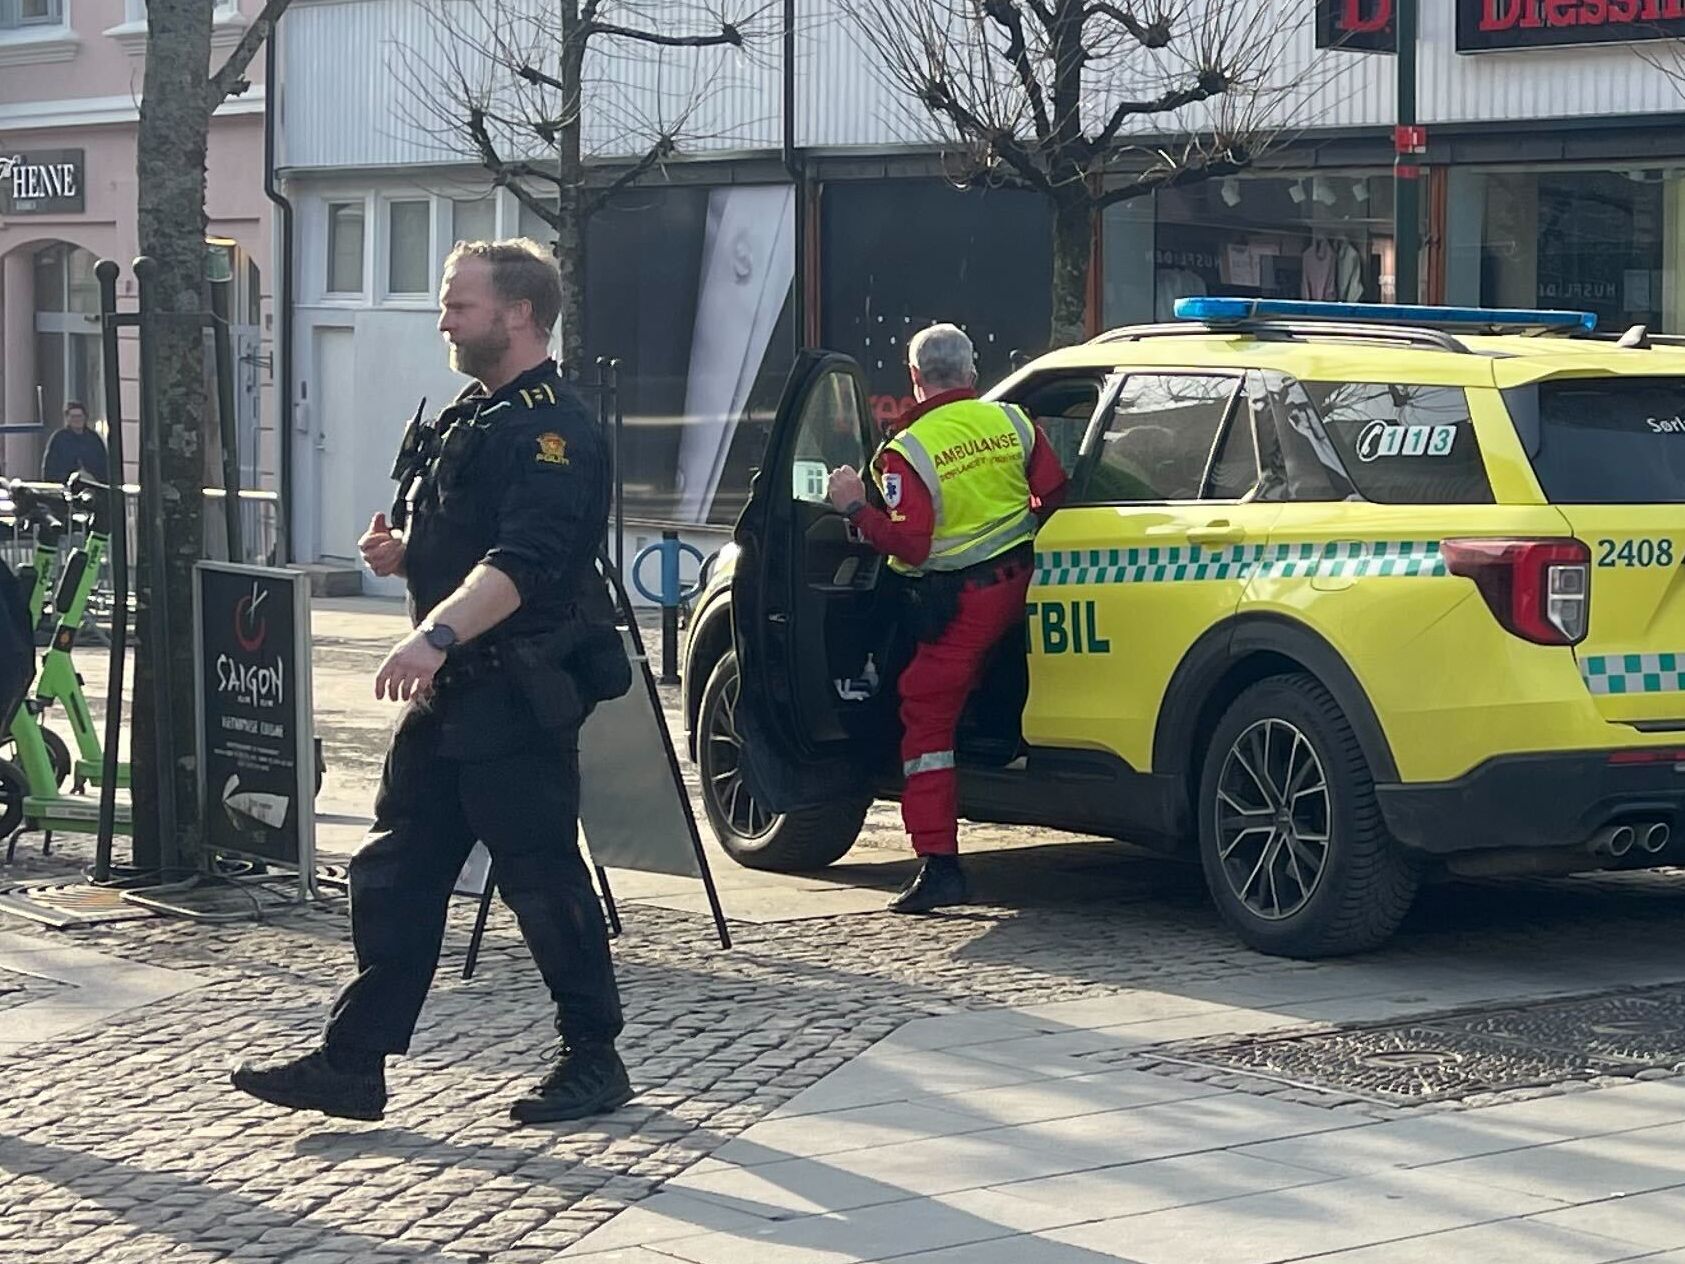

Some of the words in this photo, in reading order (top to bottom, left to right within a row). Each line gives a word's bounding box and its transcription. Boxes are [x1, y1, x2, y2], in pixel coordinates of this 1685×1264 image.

[12, 163, 76, 198] HENNE
[1384, 427, 1452, 453] 113
[1646, 416, 1685, 433] Sørl
[934, 432, 1019, 469] AMBULANSE
[1597, 538, 1673, 567] 2408
[216, 653, 283, 708] SAIGON
